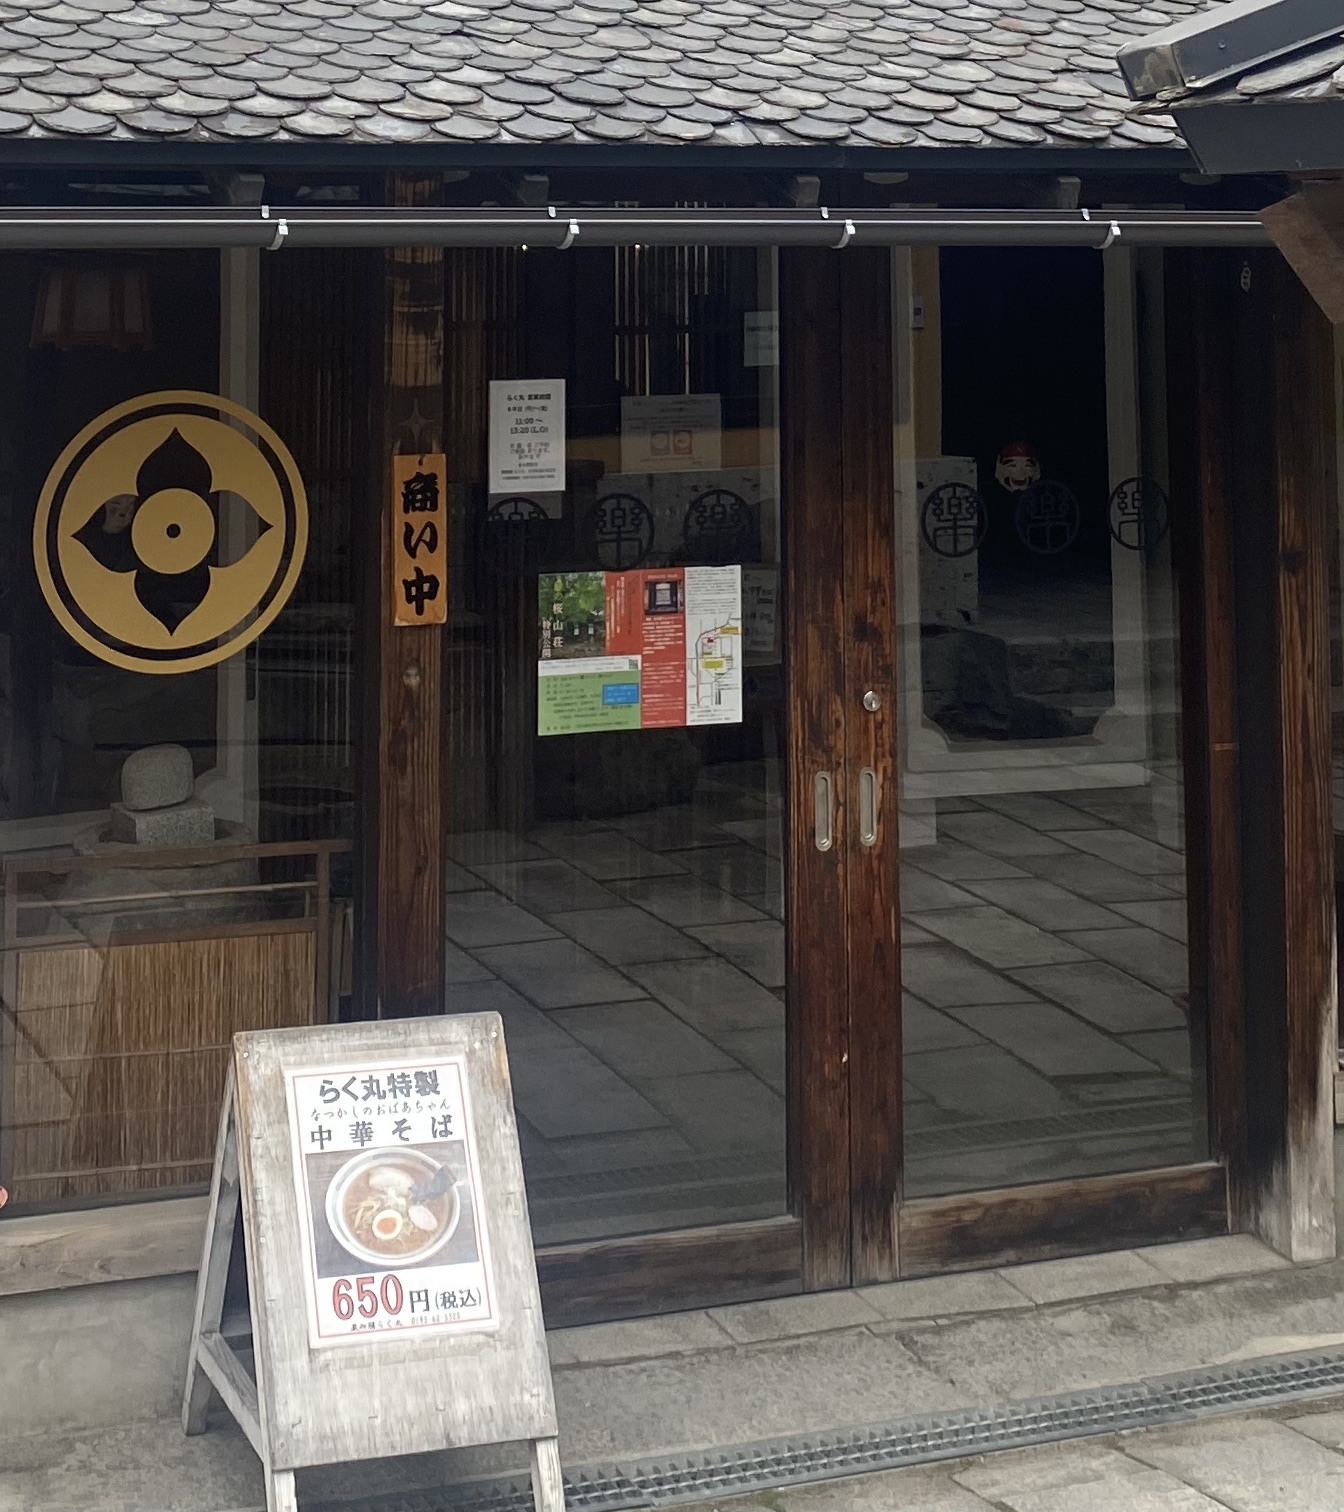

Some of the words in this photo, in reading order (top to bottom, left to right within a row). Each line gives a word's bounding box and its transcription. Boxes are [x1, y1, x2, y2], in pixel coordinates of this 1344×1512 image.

[401, 471, 440, 616] 商い中
[318, 1070, 441, 1104] らく丸特製
[310, 1114, 454, 1150] 中華そば
